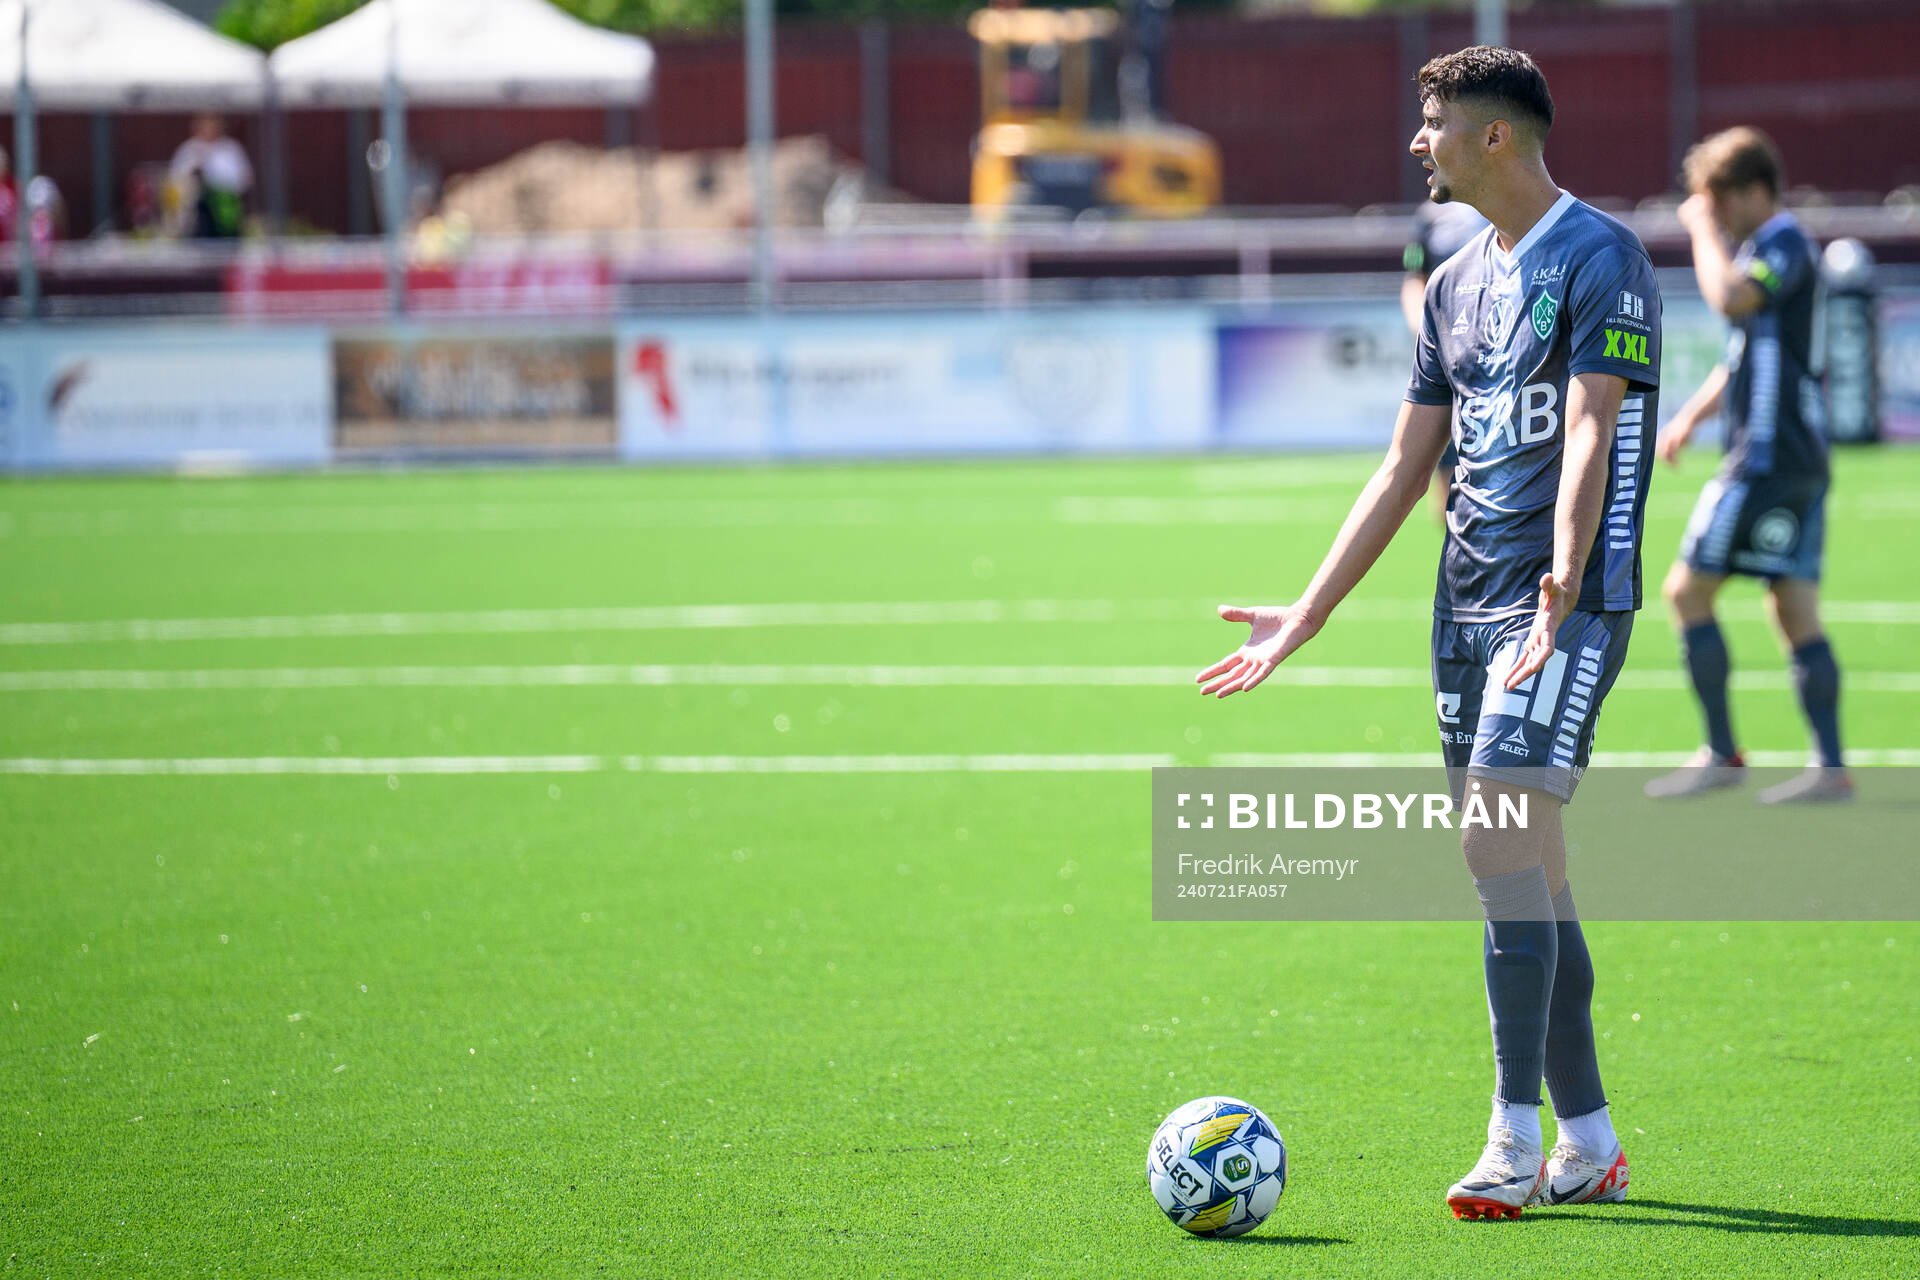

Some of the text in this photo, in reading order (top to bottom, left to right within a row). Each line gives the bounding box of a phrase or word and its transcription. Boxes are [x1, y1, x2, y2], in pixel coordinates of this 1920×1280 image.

[1603, 328, 1650, 366] XXL
[1499, 742, 1530, 758] SELECT
[1155, 1136, 1204, 1198] SELECT
